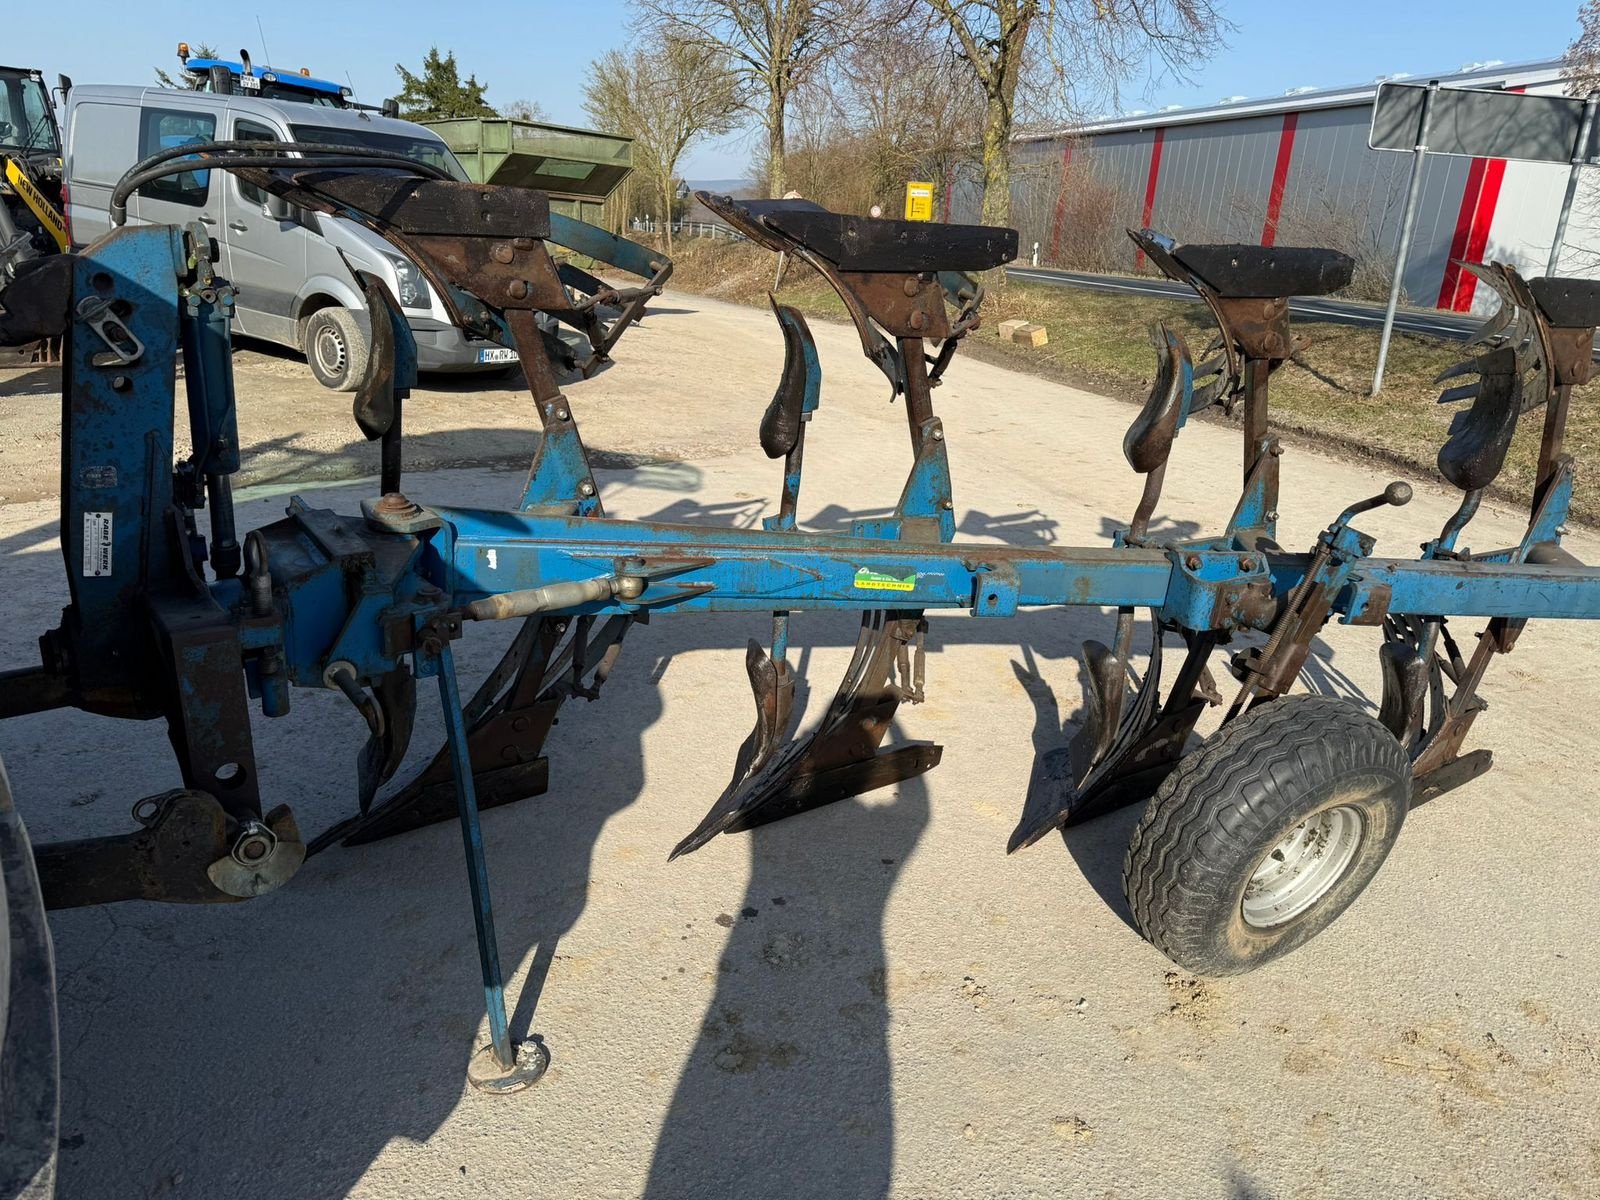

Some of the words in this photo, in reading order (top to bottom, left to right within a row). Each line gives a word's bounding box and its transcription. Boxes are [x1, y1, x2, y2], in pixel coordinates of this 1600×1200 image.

[18, 174, 33, 195] NEW
[33, 192, 63, 231] HOLLAND
[485, 350, 495, 361] HX
[499, 350, 509, 360] RW
